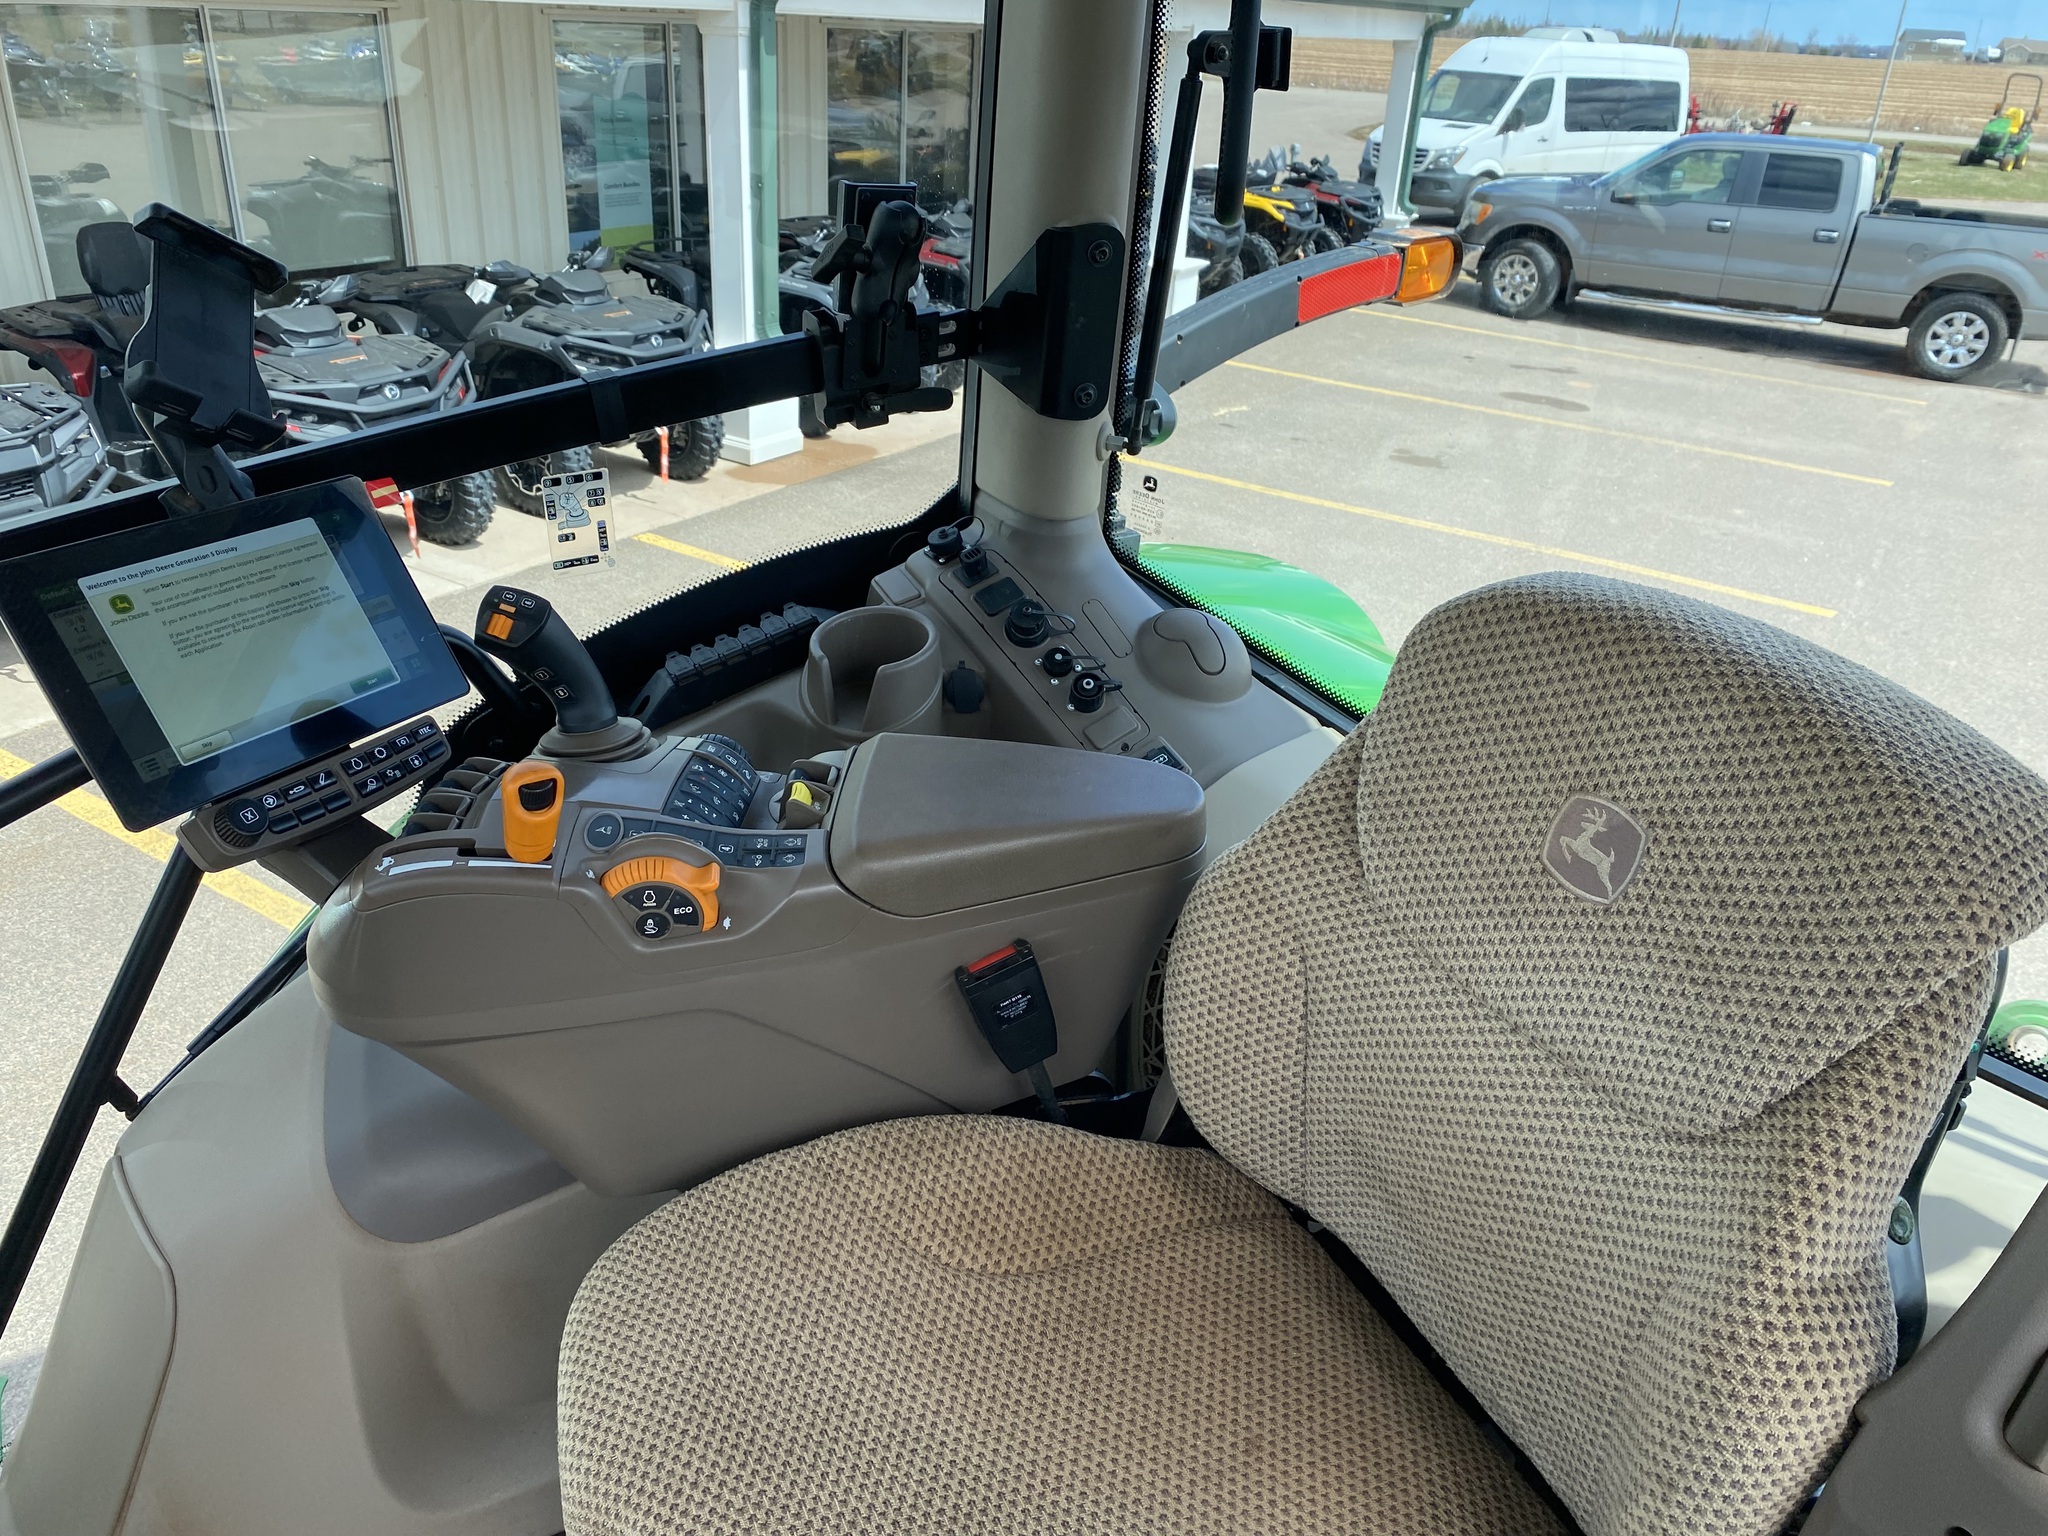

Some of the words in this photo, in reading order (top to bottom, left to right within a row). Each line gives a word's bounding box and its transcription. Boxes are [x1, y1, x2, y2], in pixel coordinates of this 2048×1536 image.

[86, 578, 118, 591] Welcome
[126, 572, 139, 580] the
[138, 568, 156, 578] John
[155, 563, 175, 572] Deere
[175, 553, 211, 567] Generation
[214, 546, 238, 556] Display
[142, 585, 160, 594] Select
[160, 581, 175, 589] Start
[181, 574, 199, 583] review
[207, 568, 221, 577] John
[220, 564, 236, 572] Deere
[236, 558, 255, 568] Display
[254, 553, 276, 562] Software
[275, 548, 293, 556] License
[293, 541, 318, 552] Agreement
[218, 576, 243, 588] governed
[286, 559, 303, 567] license
[304, 551, 329, 563] agreement
[166, 596, 201, 610] accompanies
[212, 585, 235, 596] included
[207, 601, 233, 613] purchaser
[249, 591, 268, 600] display
[267, 587, 281, 595] press
[110, 617, 128, 627] JOHN
[127, 611, 150, 621] DEERE
[174, 631, 186, 639] you
[204, 616, 231, 629] purchaser
[247, 606, 265, 615] display
[275, 597, 292, 606] choose
[298, 592, 311, 600] press
[177, 641, 201, 652] available
[207, 633, 225, 642] review
[242, 623, 257, 631] About
[266, 615, 281, 623] under
[281, 606, 309, 618] Information
[313, 599, 332, 609] Settings
[331, 594, 346, 602] within
[213, 622, 236, 634] agreeing
[250, 613, 266, 621] terms
[279, 603, 297, 612] license
[297, 595, 322, 607] agreement
[201, 741, 213, 750] Skip
[418, 726, 431, 735] ITEC
[674, 906, 692, 915] ECO
